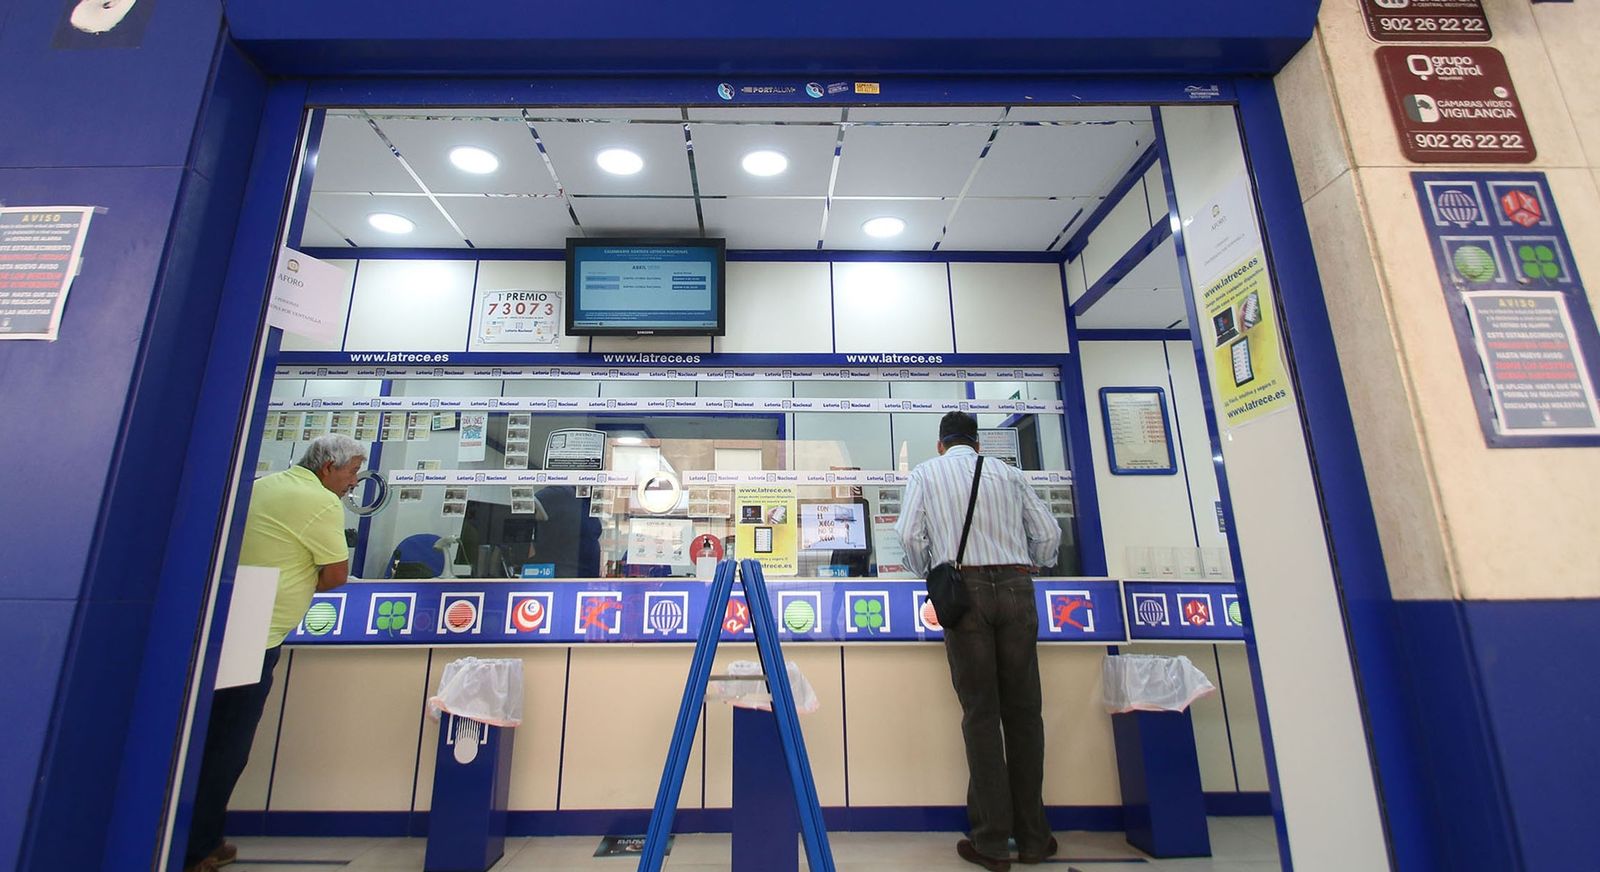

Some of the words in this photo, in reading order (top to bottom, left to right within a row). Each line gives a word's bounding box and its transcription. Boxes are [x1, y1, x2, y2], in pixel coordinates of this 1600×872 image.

[1381, 18, 1414, 30] 902
[1415, 18, 1437, 31] 26
[1439, 18, 1462, 31] 22
[1463, 18, 1485, 31] 22
[1432, 56, 1472, 67] grupo
[1434, 65, 1483, 76] control
[1440, 108, 1517, 118] VIGILANCIA
[1415, 134, 1450, 147] 902
[1451, 134, 1473, 148] 26
[1475, 135, 1499, 148] 22
[1500, 135, 1524, 148] 22
[22, 214, 61, 222] AVISO
[278, 273, 304, 288] AFORO
[1204, 257, 1258, 298] www.latrece.es
[506, 292, 547, 301] PREMIO
[488, 302, 554, 315] 73073
[1498, 299, 1536, 308] AVISO
[350, 352, 449, 363] www.latrece.es
[603, 353, 700, 364] www.latrece.es
[846, 353, 943, 364] www.latrece.es
[676, 400, 696, 408] Nacional
[1027, 403, 1045, 411] Nacional
[1227, 389, 1286, 418] www.latrece.es
